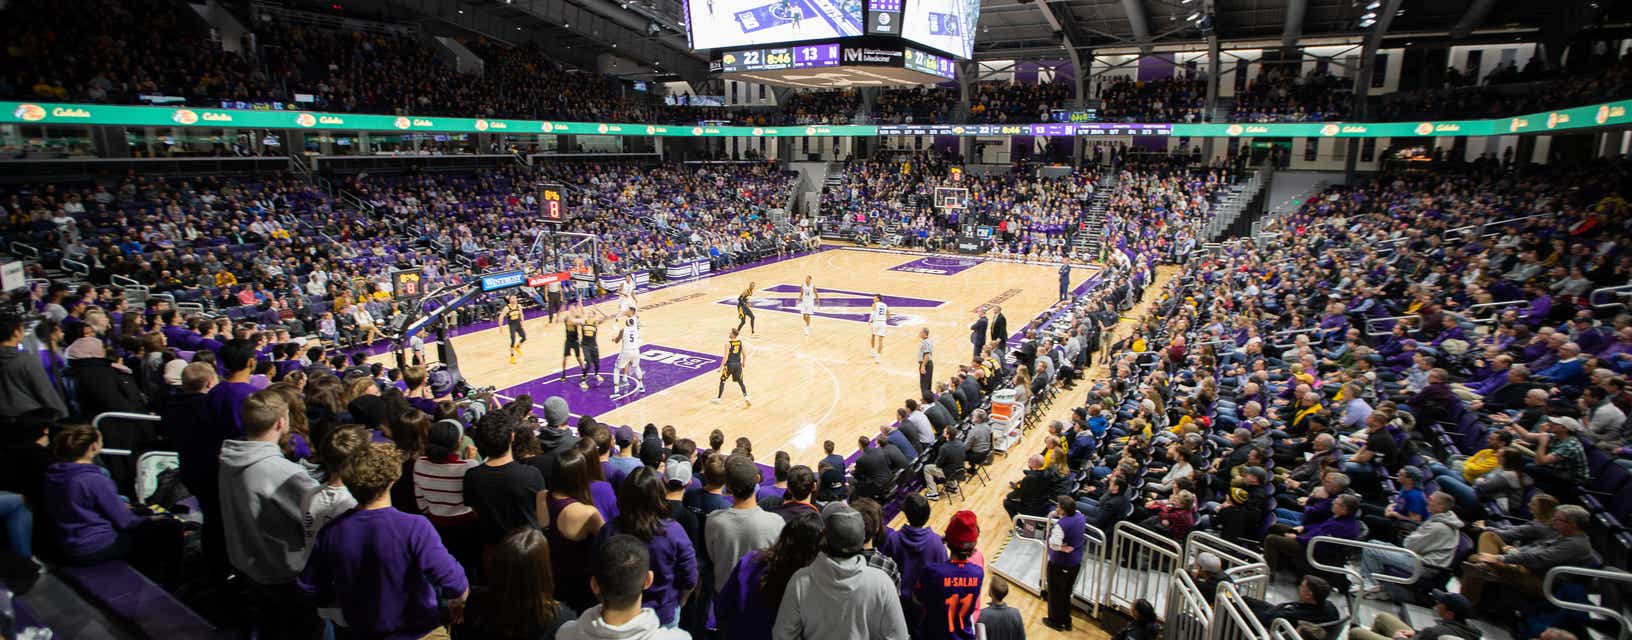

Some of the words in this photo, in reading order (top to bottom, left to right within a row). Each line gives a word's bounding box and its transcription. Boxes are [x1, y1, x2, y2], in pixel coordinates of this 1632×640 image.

[743, 52, 759, 65] 22
[802, 47, 818, 61] 13
[828, 47, 837, 59] N
[767, 54, 791, 65] 8:46
[550, 201, 562, 219] 8
[407, 283, 416, 295] 8
[628, 333, 636, 344] 5
[733, 346, 739, 354] 3
[945, 593, 974, 633] 11
